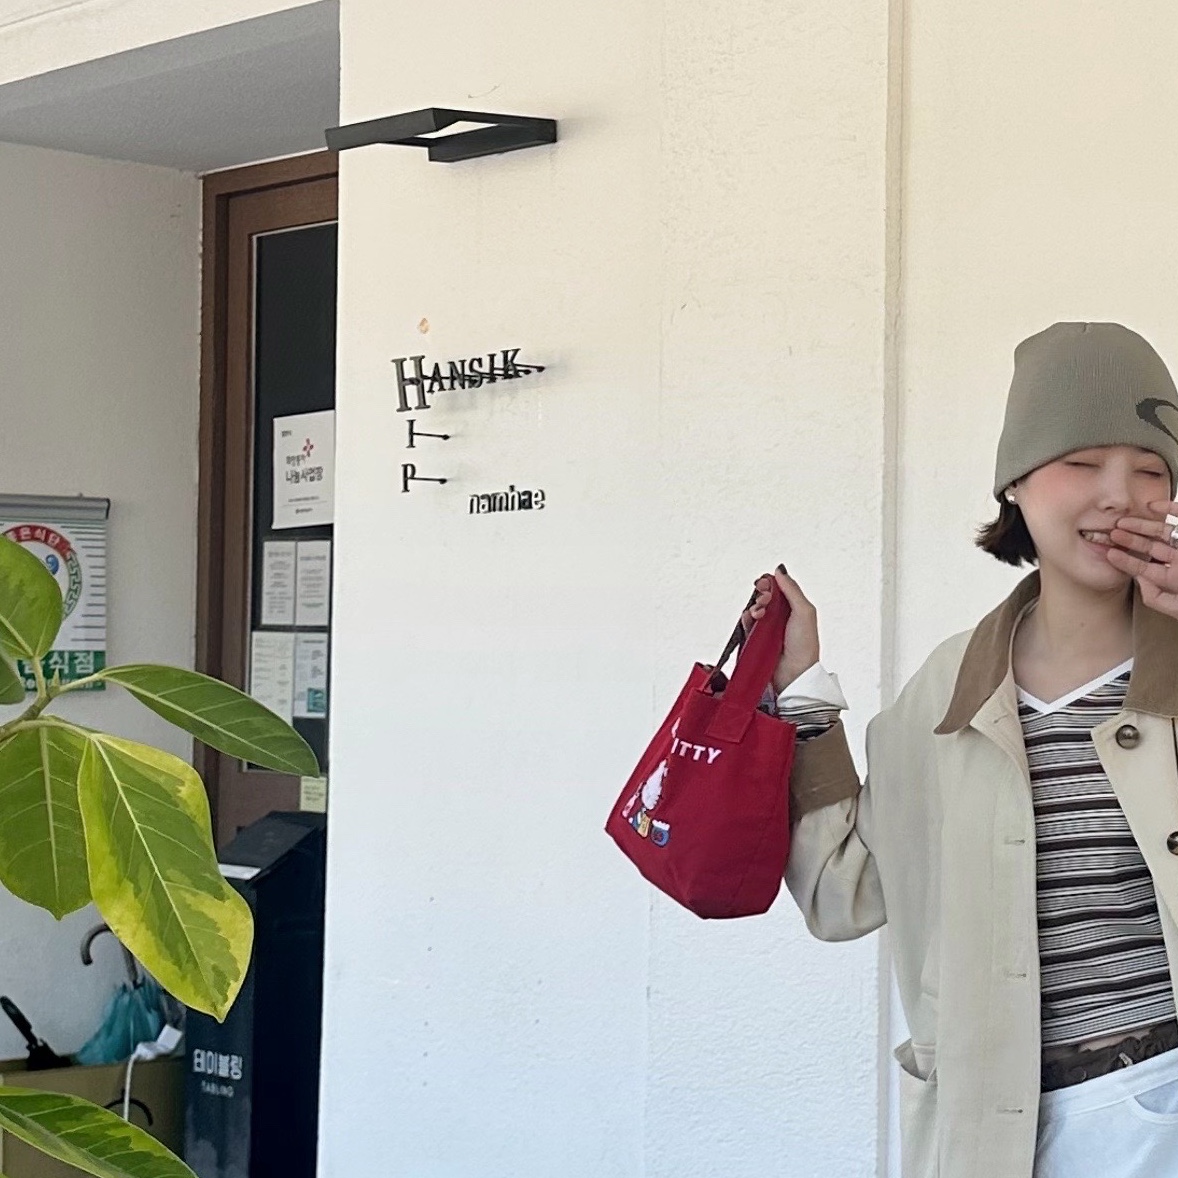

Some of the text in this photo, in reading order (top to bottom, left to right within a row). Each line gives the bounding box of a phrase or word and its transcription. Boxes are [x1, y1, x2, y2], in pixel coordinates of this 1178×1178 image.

[391, 348, 522, 412] HANSIK
[469, 485, 545, 514] namhae
[193, 1048, 242, 1080] 테이블링
